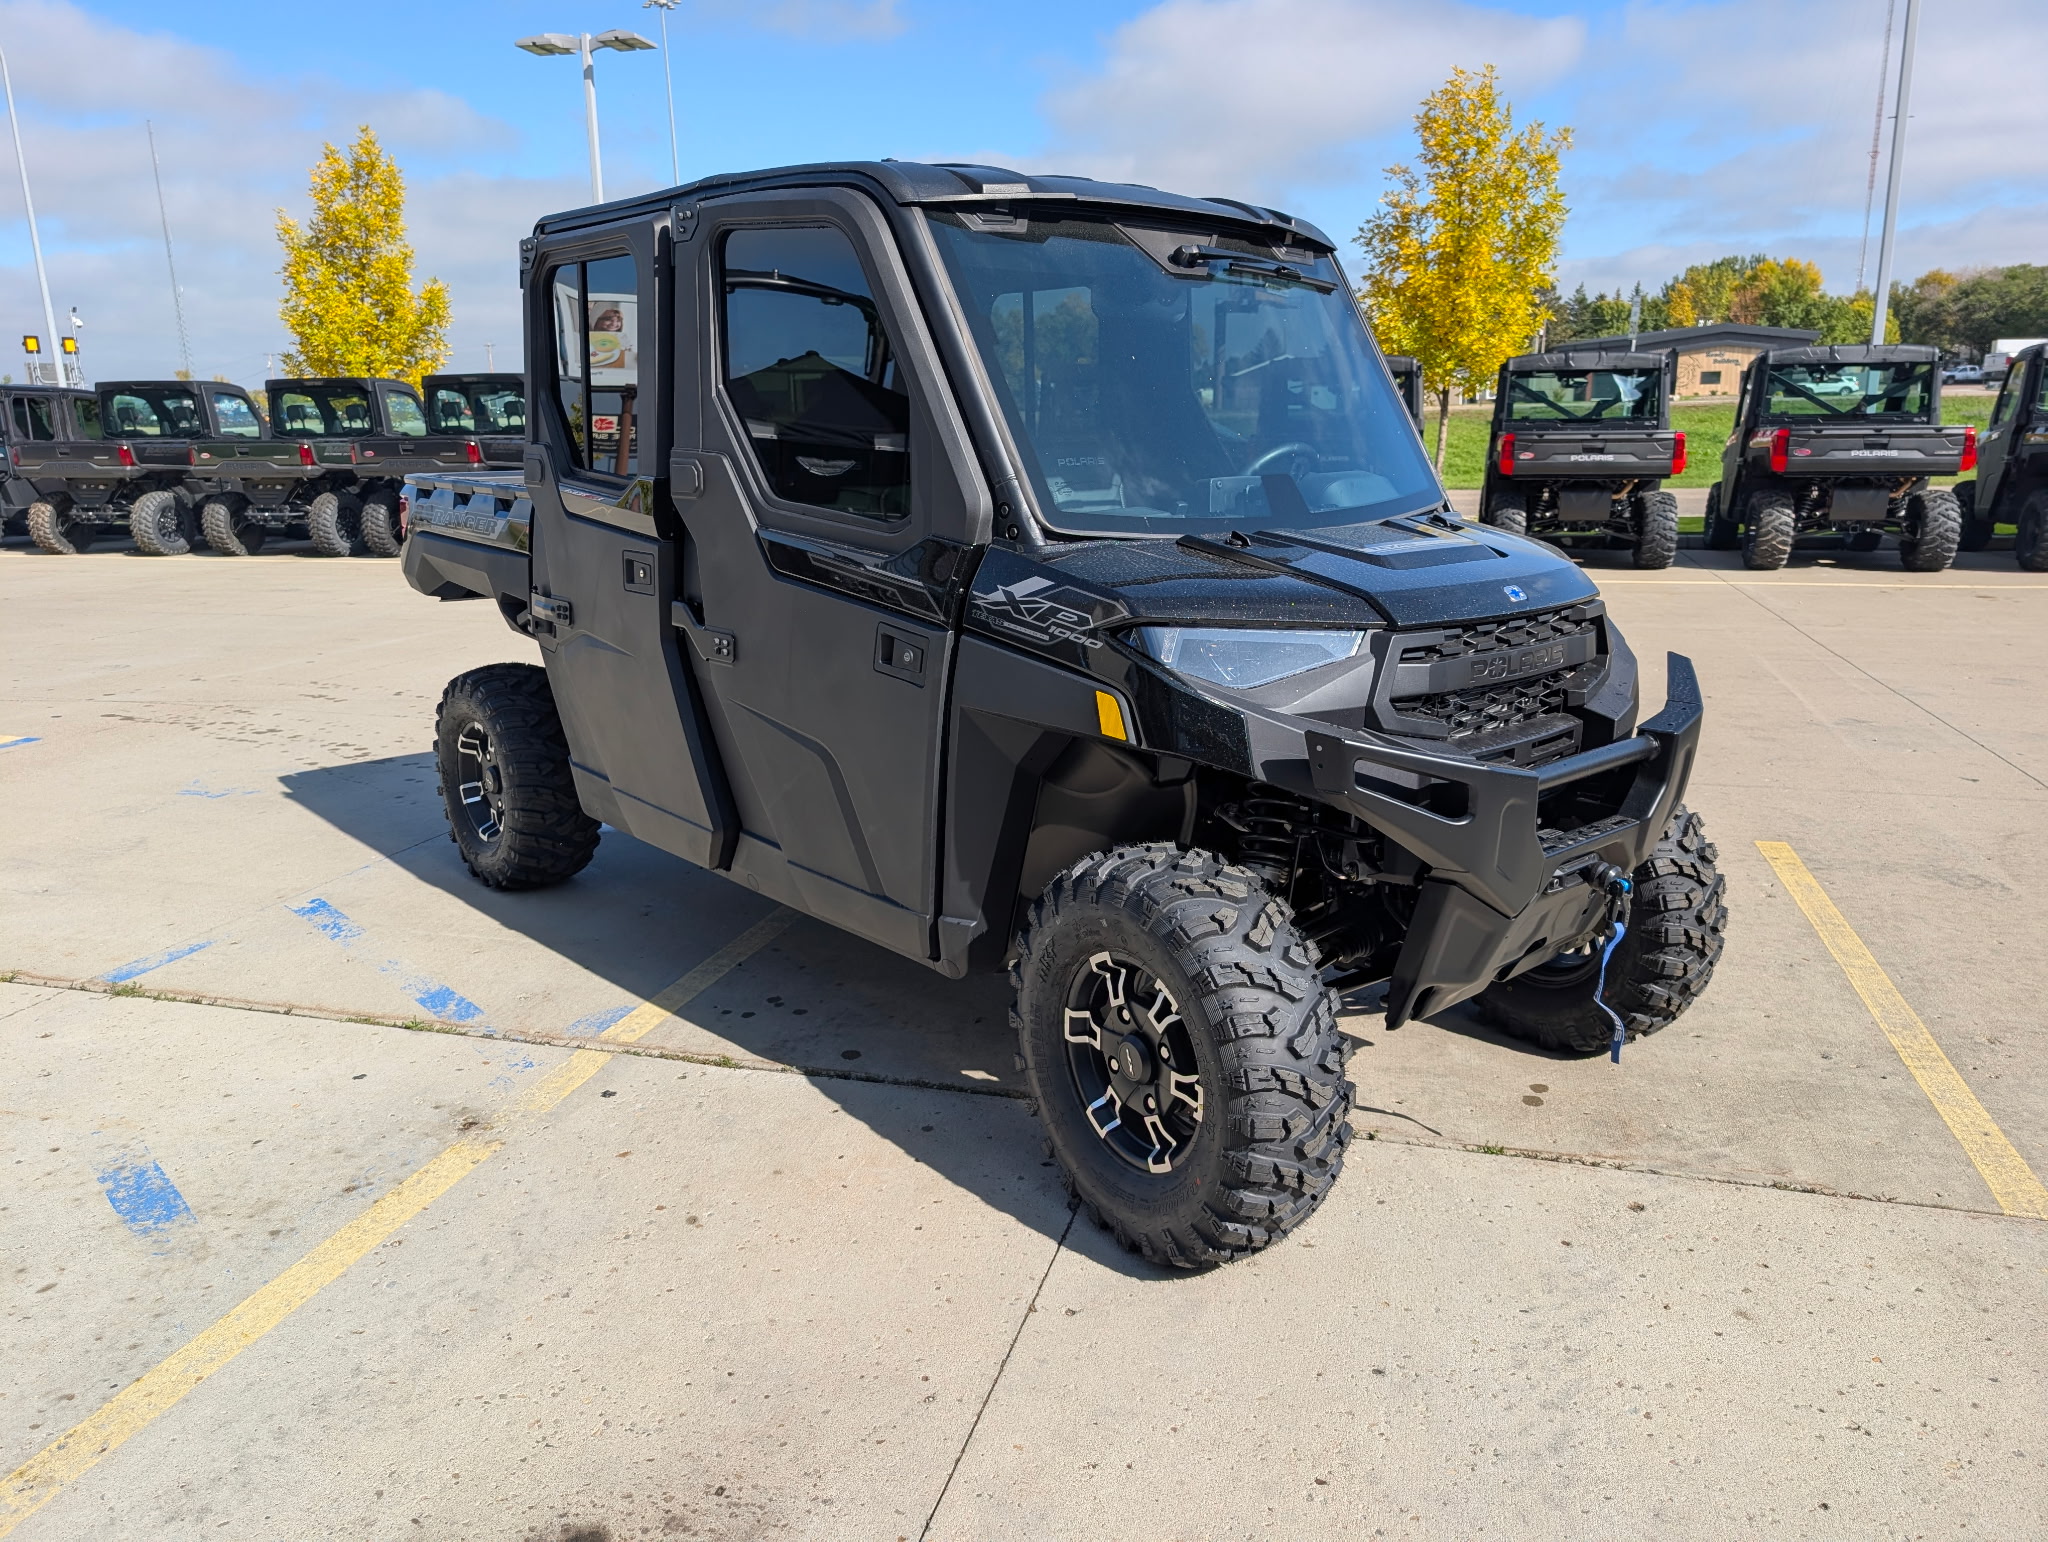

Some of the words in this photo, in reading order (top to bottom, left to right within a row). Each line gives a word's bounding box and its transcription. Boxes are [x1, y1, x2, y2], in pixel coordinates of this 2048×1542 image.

[1570, 454, 1614, 462] POLARIS
[1851, 449, 1898, 457] POLARIS
[1058, 457, 1105, 467] POLARIS
[432, 509, 498, 536] RANGER
[1047, 625, 1104, 650] 1000
[1470, 644, 1564, 681] POLARIS
